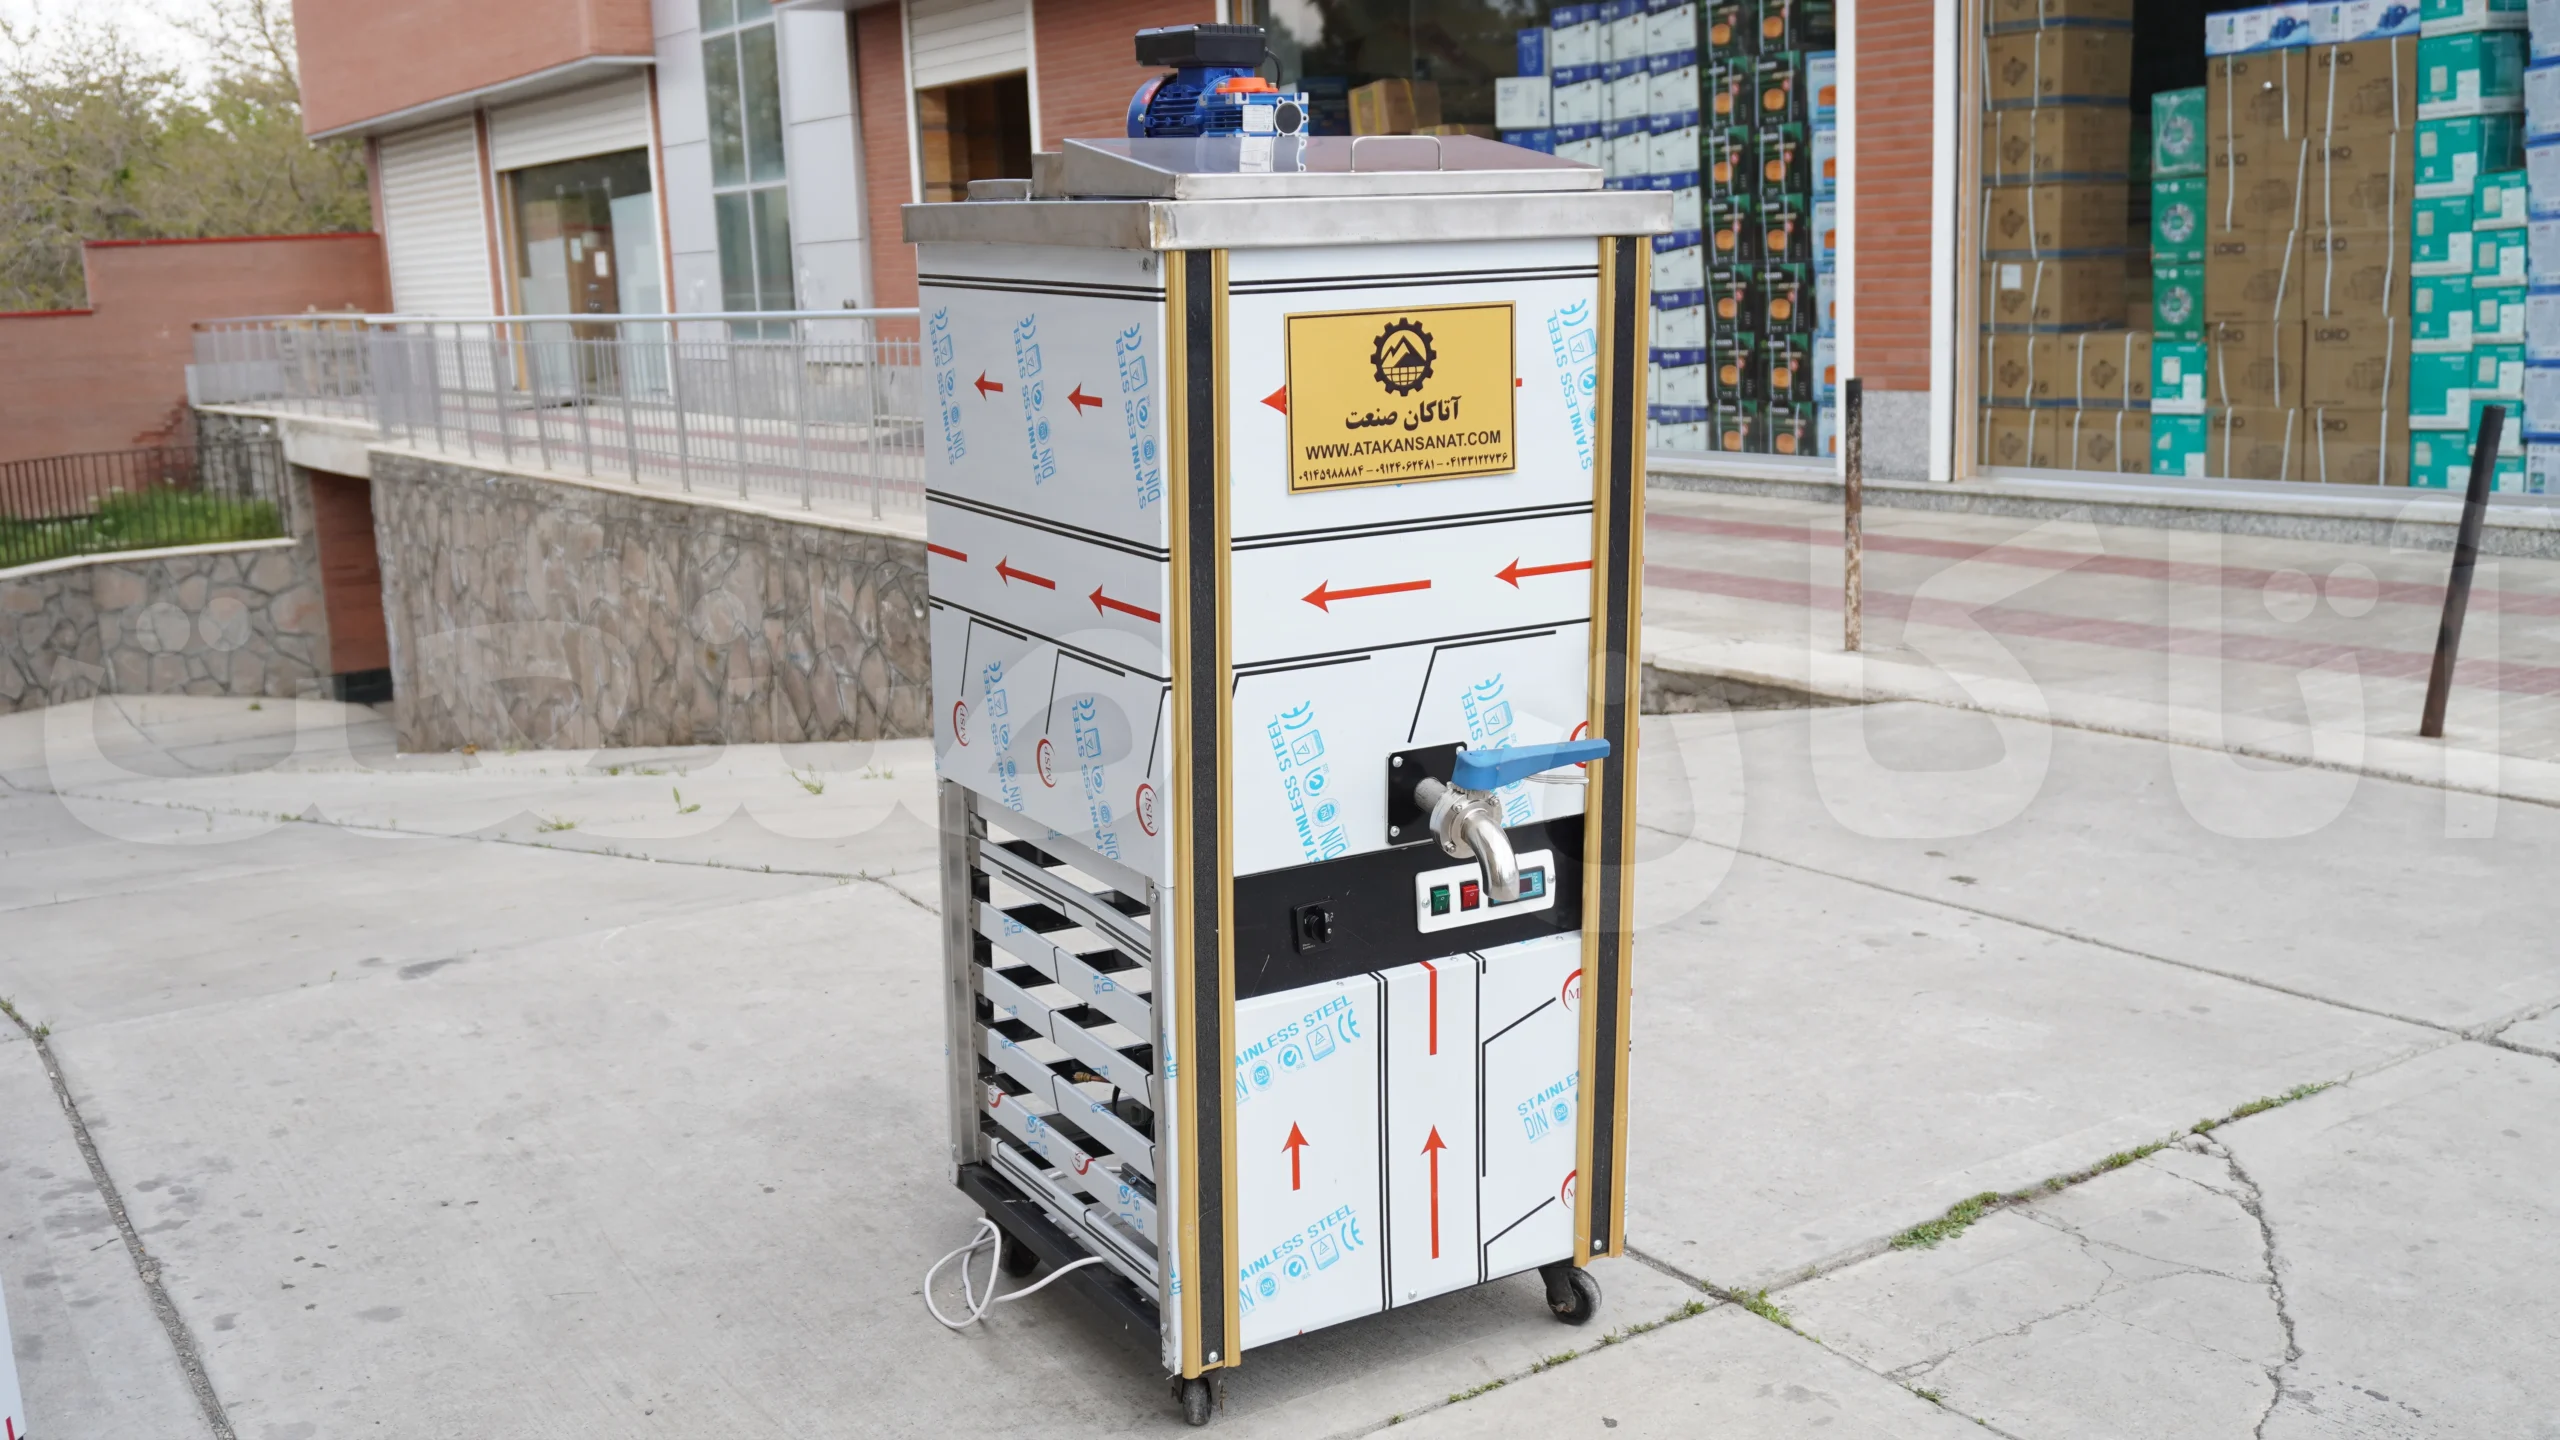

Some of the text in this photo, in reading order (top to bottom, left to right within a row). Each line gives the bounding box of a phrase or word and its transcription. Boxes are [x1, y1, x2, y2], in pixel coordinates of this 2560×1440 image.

[929, 313, 954, 465] STAINLESS STEEL
[1013, 320, 1041, 485] STAINLESS STEEL
[1547, 309, 1592, 470] STAINLESS STEEL
[1116, 330, 1147, 509] STAINLESS STEEL
[1345, 395, 1462, 431] آتاکان صنعت
[952, 430, 965, 459] DIN
[1039, 447, 1054, 479] DIN
[1305, 430, 1500, 460] WWW.ATAKANSANAT.COM
[1144, 468, 1161, 503] DIN
[1461, 686, 1483, 741] STEEL
[983, 663, 1010, 809] TAINLESS STEEL
[1072, 700, 1104, 852] TAINLESS STEEL
[1267, 714, 1320, 863] TAINLESS STEEL
[1009, 786, 1023, 812] DIN
[1144, 791, 1154, 829] MSP
[1505, 793, 1532, 826] DIN
[1103, 832, 1118, 860] DIN
[1318, 825, 1347, 861] DIN
[1236, 995, 1353, 1068] AINLESS STEEL
[1517, 1070, 1579, 1116] STAINLE
[1524, 1108, 1549, 1140] DIN
[1240, 1204, 1356, 1282] AINLESS STEEL
